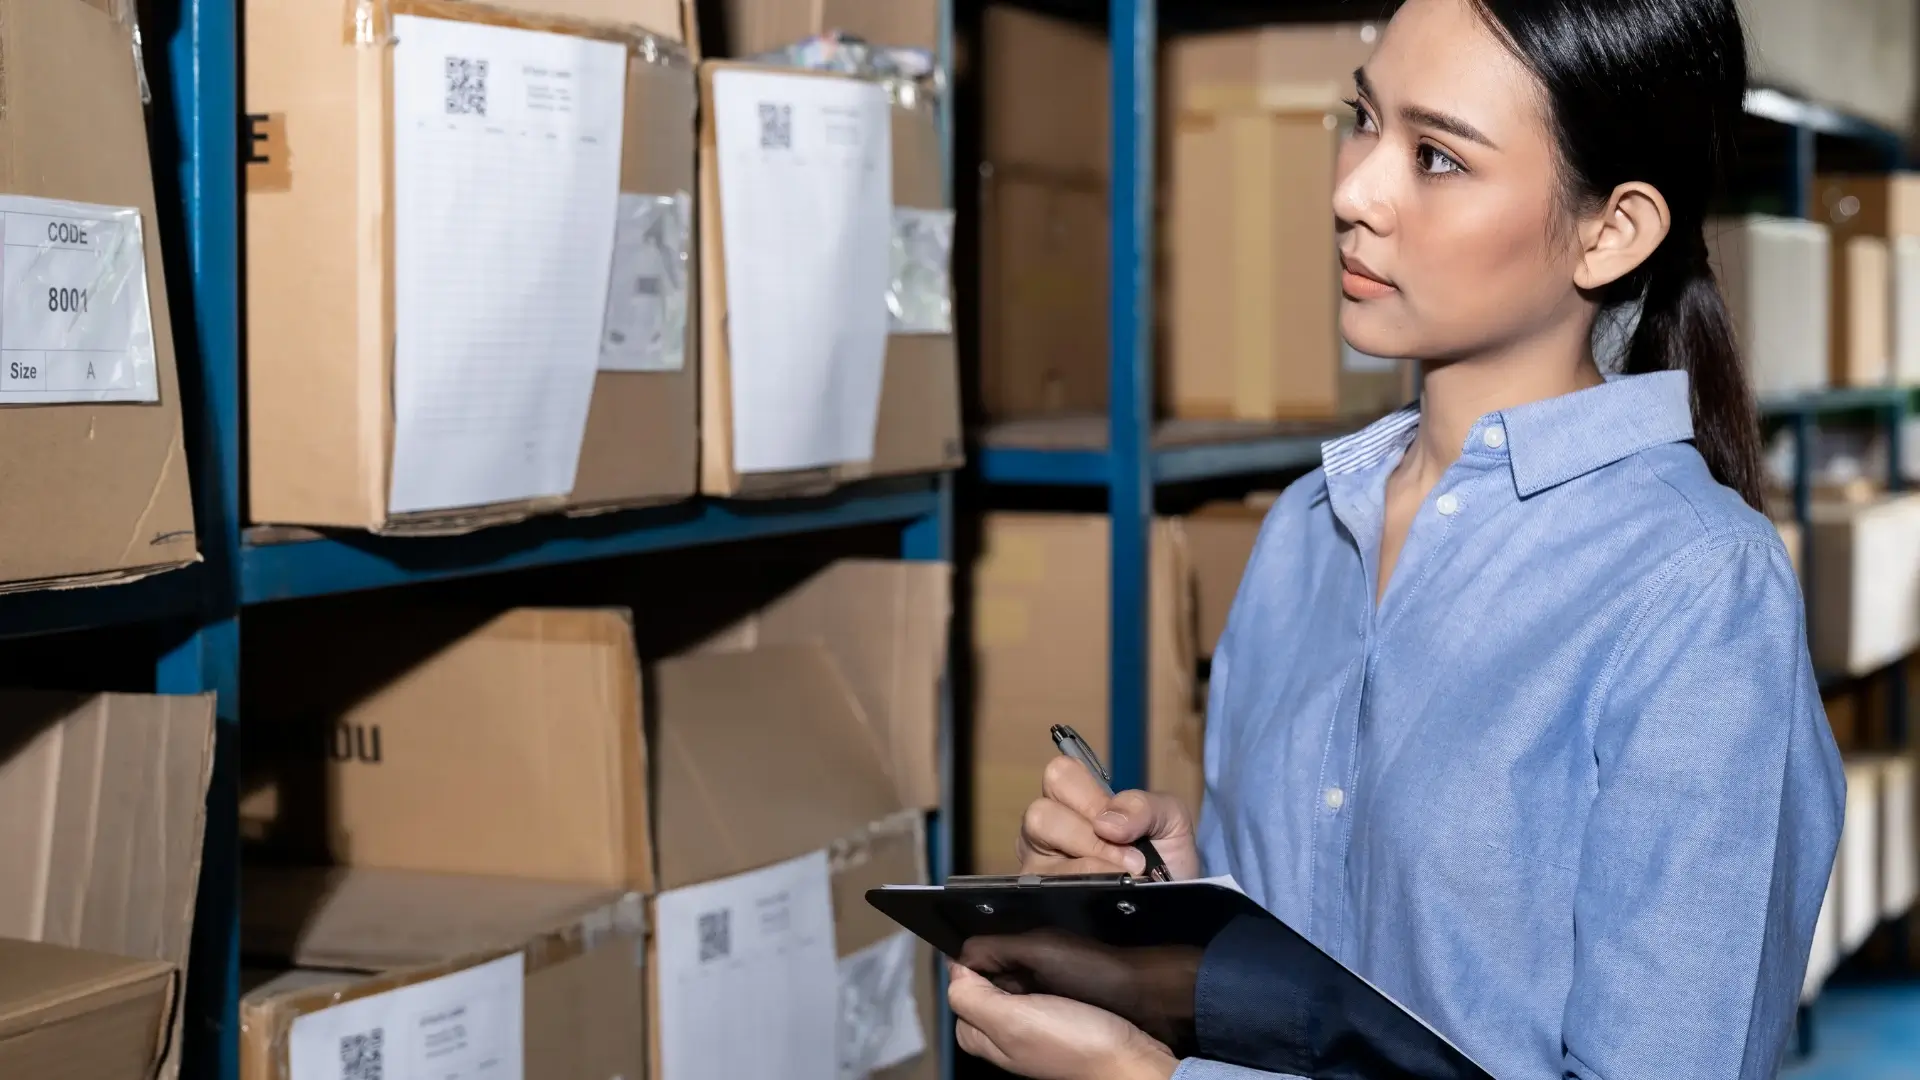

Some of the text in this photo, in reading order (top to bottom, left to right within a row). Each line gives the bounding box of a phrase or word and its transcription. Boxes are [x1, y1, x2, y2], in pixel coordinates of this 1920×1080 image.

[48, 221, 88, 245] CODE
[48, 287, 88, 313] 8001
[10, 361, 96, 380] Size A
